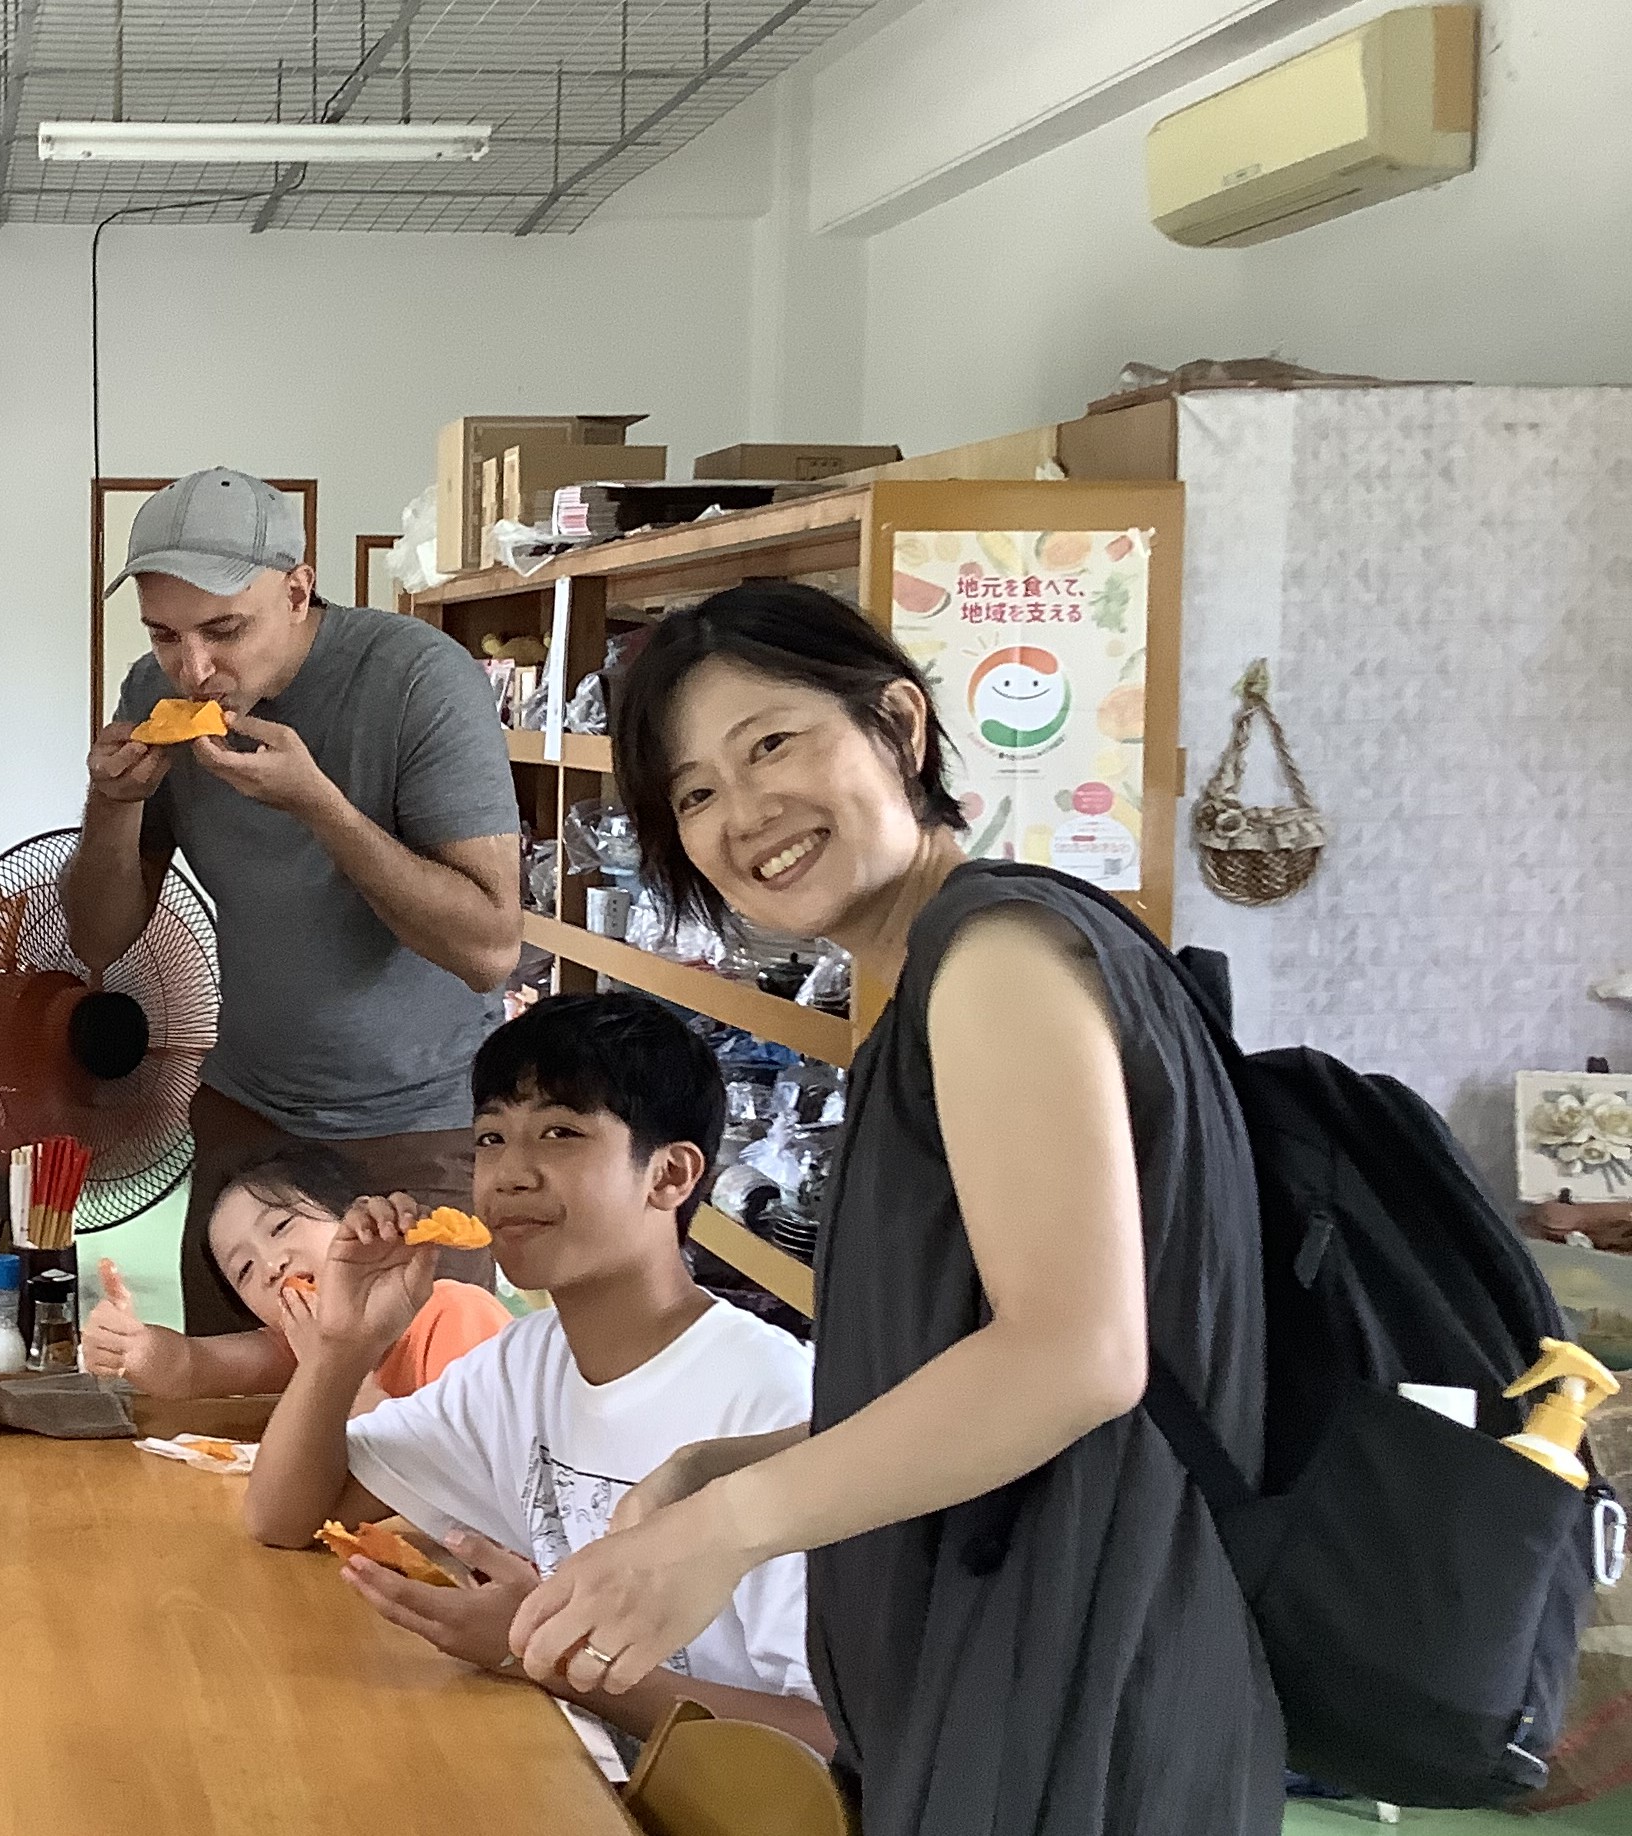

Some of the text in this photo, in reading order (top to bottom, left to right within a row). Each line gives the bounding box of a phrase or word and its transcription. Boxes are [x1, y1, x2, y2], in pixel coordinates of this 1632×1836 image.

[957, 576, 1085, 598] 地元を食べて、
[961, 602, 1082, 623] 地域を支える
